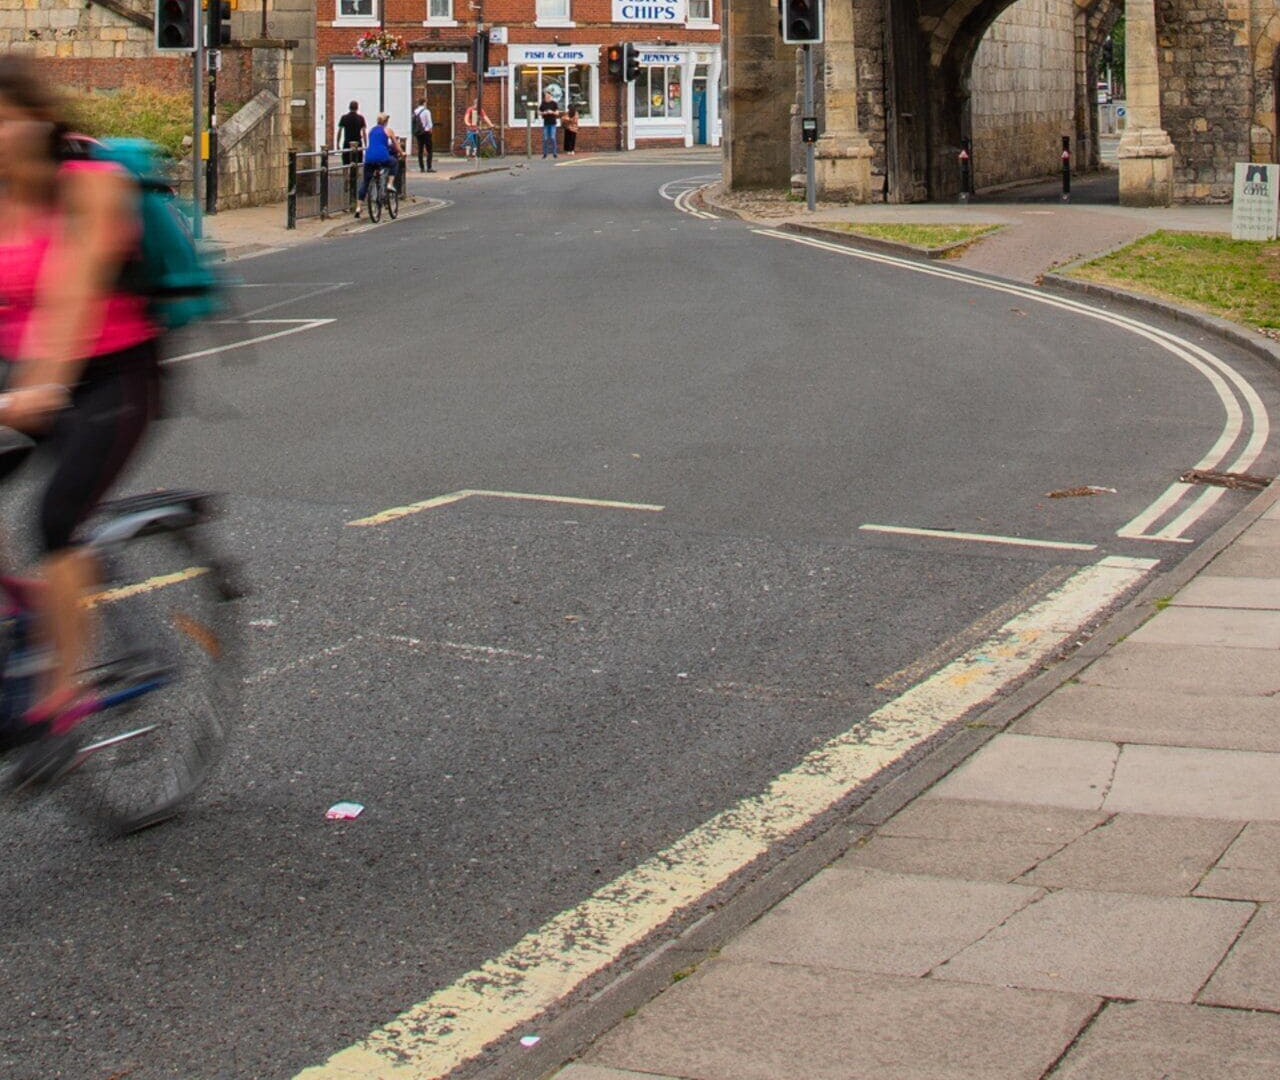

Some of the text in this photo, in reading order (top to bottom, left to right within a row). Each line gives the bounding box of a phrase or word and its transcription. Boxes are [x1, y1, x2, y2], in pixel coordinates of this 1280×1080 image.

[622, 5, 675, 20] CHIPS
[524, 51, 584, 59] FISH & CHIPS
[641, 53, 680, 62] JENNY'S
